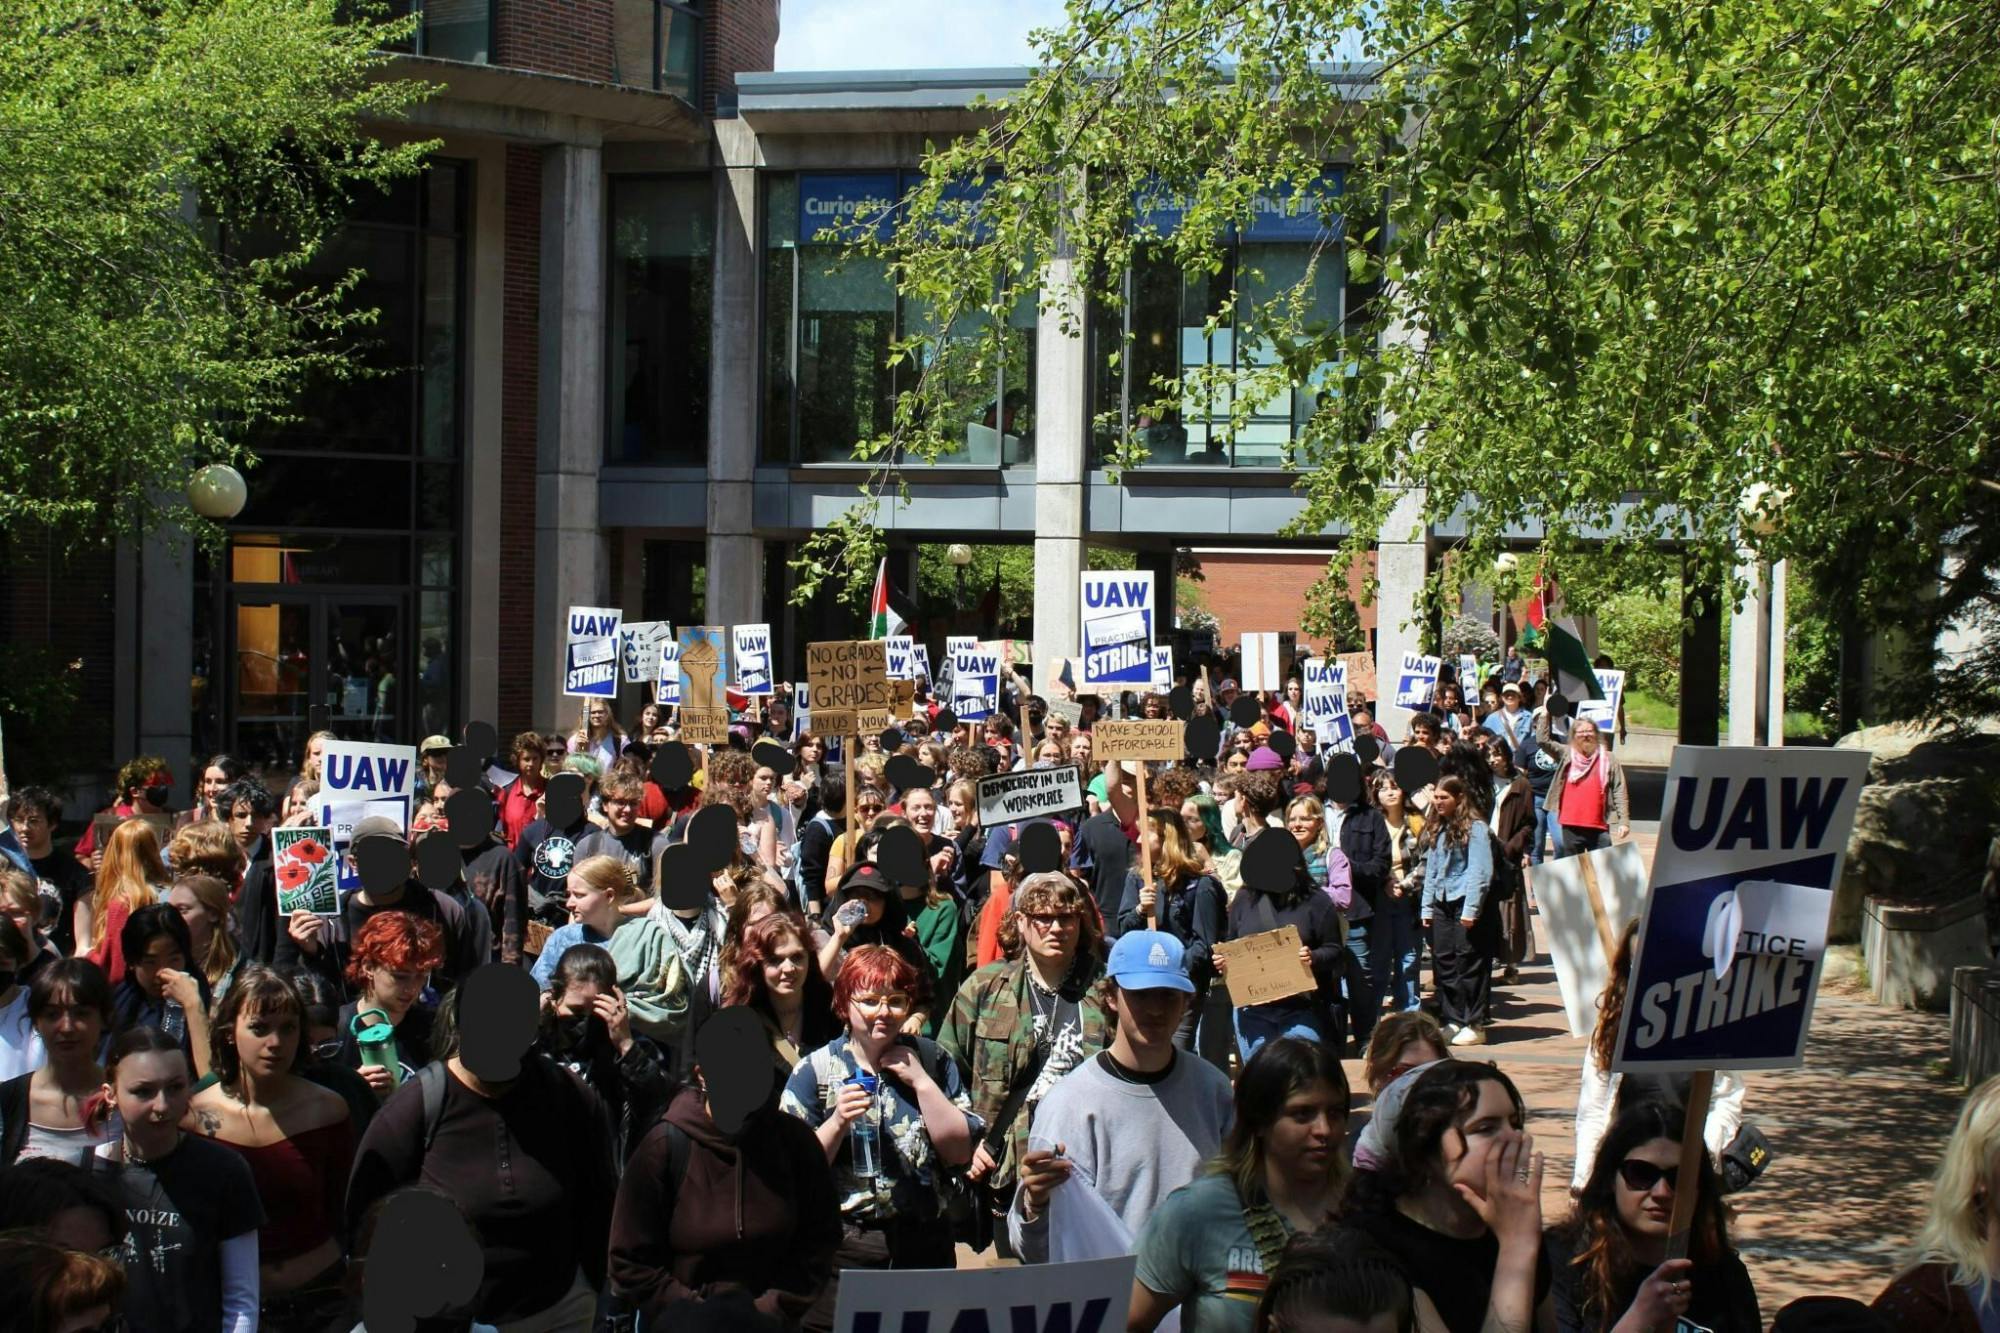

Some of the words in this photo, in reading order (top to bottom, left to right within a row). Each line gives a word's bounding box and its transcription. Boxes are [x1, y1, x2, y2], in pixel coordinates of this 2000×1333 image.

[1085, 582, 1148, 608] UAW
[571, 614, 618, 637] UAW
[740, 636, 767, 652] UAW
[1094, 630, 1140, 645] PRACTICE
[810, 647, 832, 664] NO
[957, 655, 997, 673] UAW
[1087, 640, 1149, 679] STRIKE
[832, 664, 858, 682] NO
[1306, 666, 1344, 683] UAW
[1404, 656, 1438, 675] UAW
[568, 663, 614, 690] STRIKE
[956, 694, 995, 717] STRIKE
[1311, 694, 1343, 717] UAW
[832, 714, 849, 730] US
[861, 715, 889, 729] NOW
[1096, 723, 1130, 738] MAKE
[1134, 723, 1176, 738] SCHOOL
[1101, 738, 1176, 753] AFFORDABLE
[326, 754, 409, 793] UAW
[1041, 773, 1053, 787] IN
[1056, 770, 1075, 783] OUR
[1003, 789, 1063, 814] WORKPLACE
[1671, 777, 1848, 852] UAW
[275, 829, 331, 851] PALESTINE
[311, 881, 334, 900] BE
[1635, 955, 1804, 1049] STRIKE
